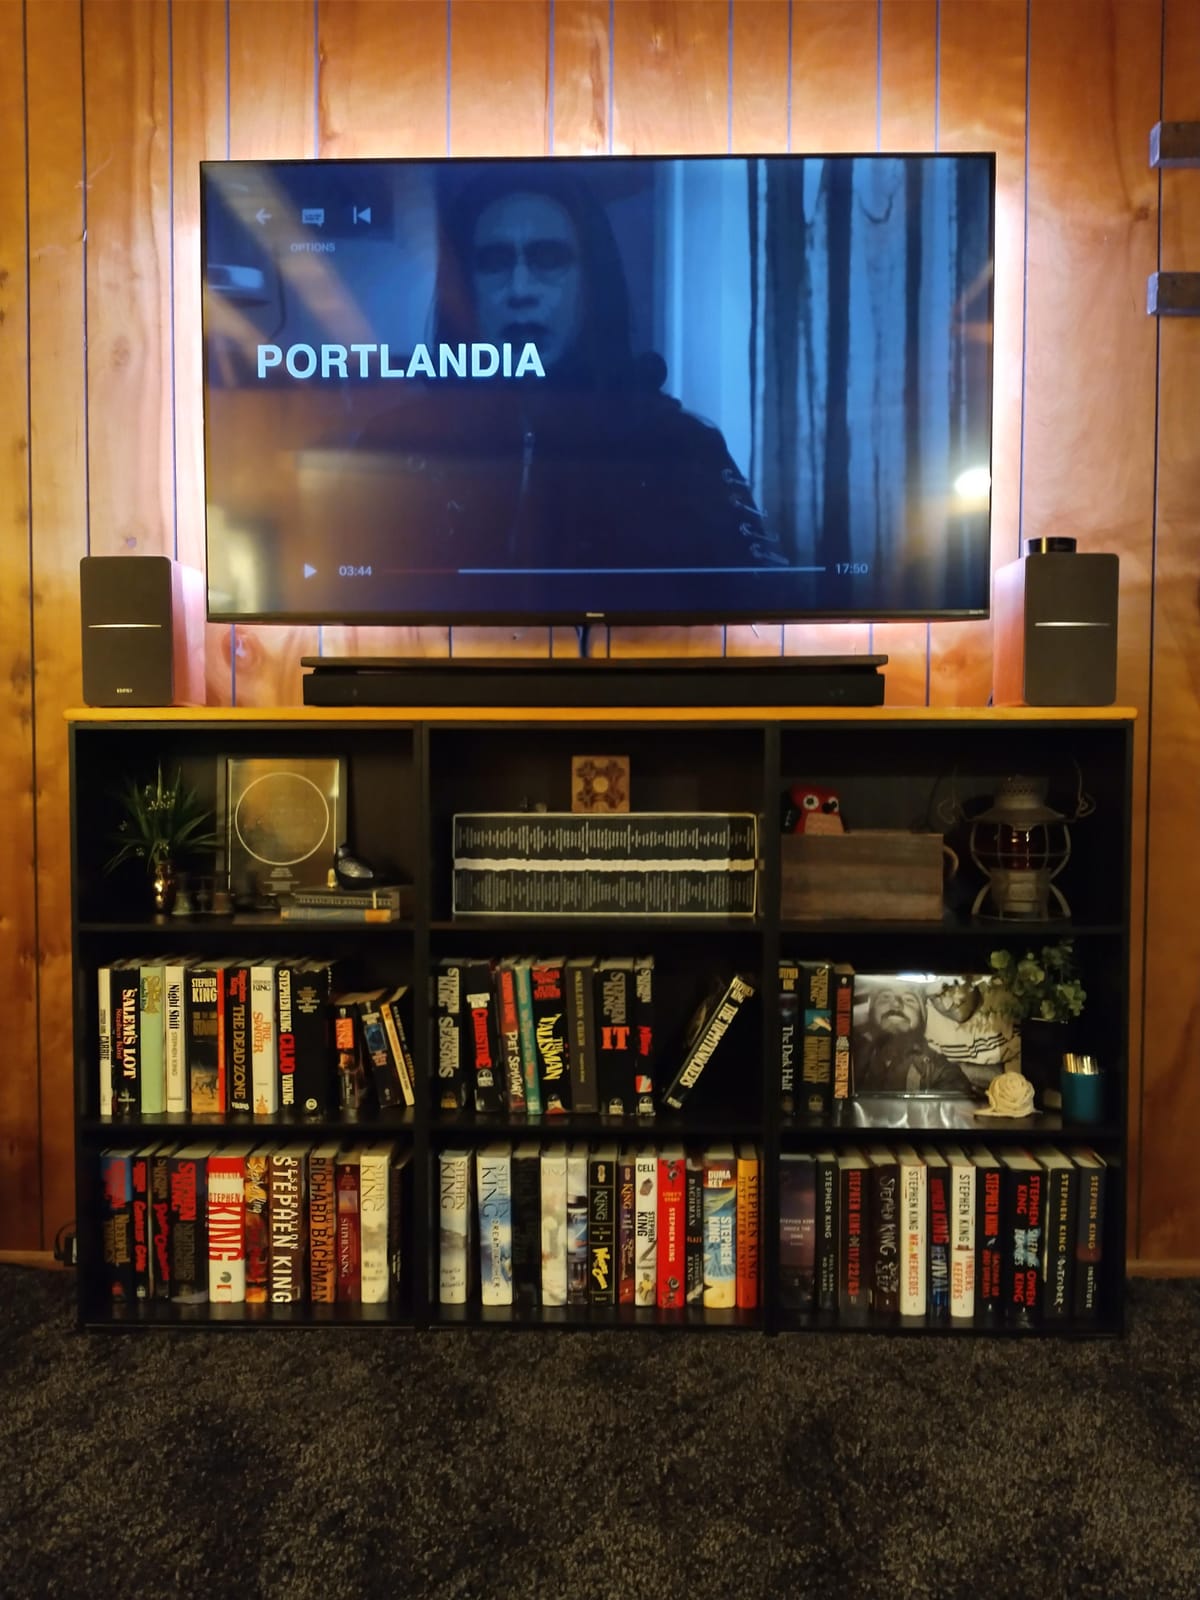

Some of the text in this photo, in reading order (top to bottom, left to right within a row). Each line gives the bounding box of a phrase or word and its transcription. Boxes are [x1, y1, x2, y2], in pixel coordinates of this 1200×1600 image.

[290, 242, 336, 253] OPTIONS
[257, 343, 545, 379] PORTLANDIA
[338, 565, 372, 577] 03:44
[835, 563, 869, 575] 17:50
[192, 977, 217, 987] STEPHEN
[192, 987, 218, 1003] KING
[438, 976, 449, 1008] KING
[447, 967, 460, 1014] STEPHEN
[603, 981, 613, 1016] KING
[610, 971, 626, 1024] STEPHEN
[809, 975, 818, 1003] KING
[816, 967, 829, 1009] STEPHEN
[167, 985, 180, 1029] Night Shift
[232, 1004, 246, 1029] THE
[575, 970, 585, 1047] SKELETON CREW
[232, 1030, 246, 1065] DEAD
[263, 1021, 271, 1042] FIRE
[279, 969, 296, 1105] STEPHEN KING CUJO VIKING
[336, 1021, 345, 1048] KING
[438, 1016, 454, 1078] SEASONS
[471, 1008, 493, 1070] CHRISTINE
[504, 1029, 520, 1055] PET
[536, 1013, 565, 1081] TALISMAN
[553, 1036, 564, 1053] THE
[601, 1026, 630, 1051] IT
[679, 1002, 739, 1089] THE TOMMYKNOCKERS
[122, 1048, 137, 1080] LOT
[507, 1056, 524, 1098] SEMATARY
[782, 1024, 794, 1092] The Dark Half
[817, 1061, 832, 1084] PAST
[833, 1050, 849, 1099] STEPHEN KING
[232, 1065, 246, 1099] ZONE
[247, 1159, 267, 1198] Stephen
[361, 1164, 376, 1212] KING
[375, 1164, 385, 1212] STEPHEN
[441, 1161, 456, 1210] KING
[455, 1161, 466, 1210] STEPHEN
[637, 1163, 656, 1173] CELL
[708, 1170, 732, 1179] DUMA
[708, 1179, 723, 1188] KEY
[171, 1172, 184, 1212] KING
[178, 1161, 197, 1221] STEPHEN
[208, 1193, 241, 1203] STEPHEN
[247, 1197, 267, 1215] King
[287, 1160, 300, 1250] DESPERATION
[482, 1166, 498, 1218] KING
[497, 1165, 509, 1218] STEPHEN
[593, 1190, 608, 1221] KING
[621, 1183, 634, 1210] KING
[688, 1178, 697, 1227] BACHMAN
[738, 1176, 746, 1201] JUST
[824, 1170, 833, 1239] STEPHEN KING
[959, 1174, 971, 1243] STEPHEN KING
[984, 1172, 1000, 1237] STEPHEN KING
[1016, 1184, 1028, 1215] KING
[1029, 1175, 1041, 1226] STEPHEN
[1060, 1173, 1070, 1222] STEPHEN
[208, 1203, 242, 1261] KING
[271, 1155, 293, 1304] STEPHEN KING
[311, 1157, 327, 1304] RICHARD BACHMAN
[638, 1211, 648, 1237] KING
[648, 1211, 656, 1243] STEPHEN
[708, 1216, 721, 1244] KING
[738, 1204, 746, 1234] AFTER
[747, 1175, 758, 1280] STEPHEN KING
[879, 1176, 897, 1256] STEPHEN KING
[931, 1212, 950, 1245] KING
[1087, 1175, 1100, 1250] STEPHEN KING
[113, 1213, 131, 1267] NEEDFUL
[183, 1223, 196, 1281] NIGHTMARES
[340, 1217, 349, 1256] STEPHEN
[668, 1207, 676, 1262] STEPHEN KING
[720, 1216, 733, 1266] STEPHEN
[847, 1170, 862, 1297] STEPHEN KING 11/22/63
[908, 1170, 919, 1297] STEPHEN KING MERCEDES
[1058, 1224, 1068, 1253] KING
[687, 1255, 695, 1281] KING
[930, 1245, 949, 1296] REVIVAL
[953, 1261, 963, 1300] KEEPERS
[965, 1255, 974, 1292] FINDERS
[1013, 1271, 1025, 1304] KING
[1025, 1270, 1038, 1306] OWEN
[1086, 1265, 1095, 1309] INSTITUTE
